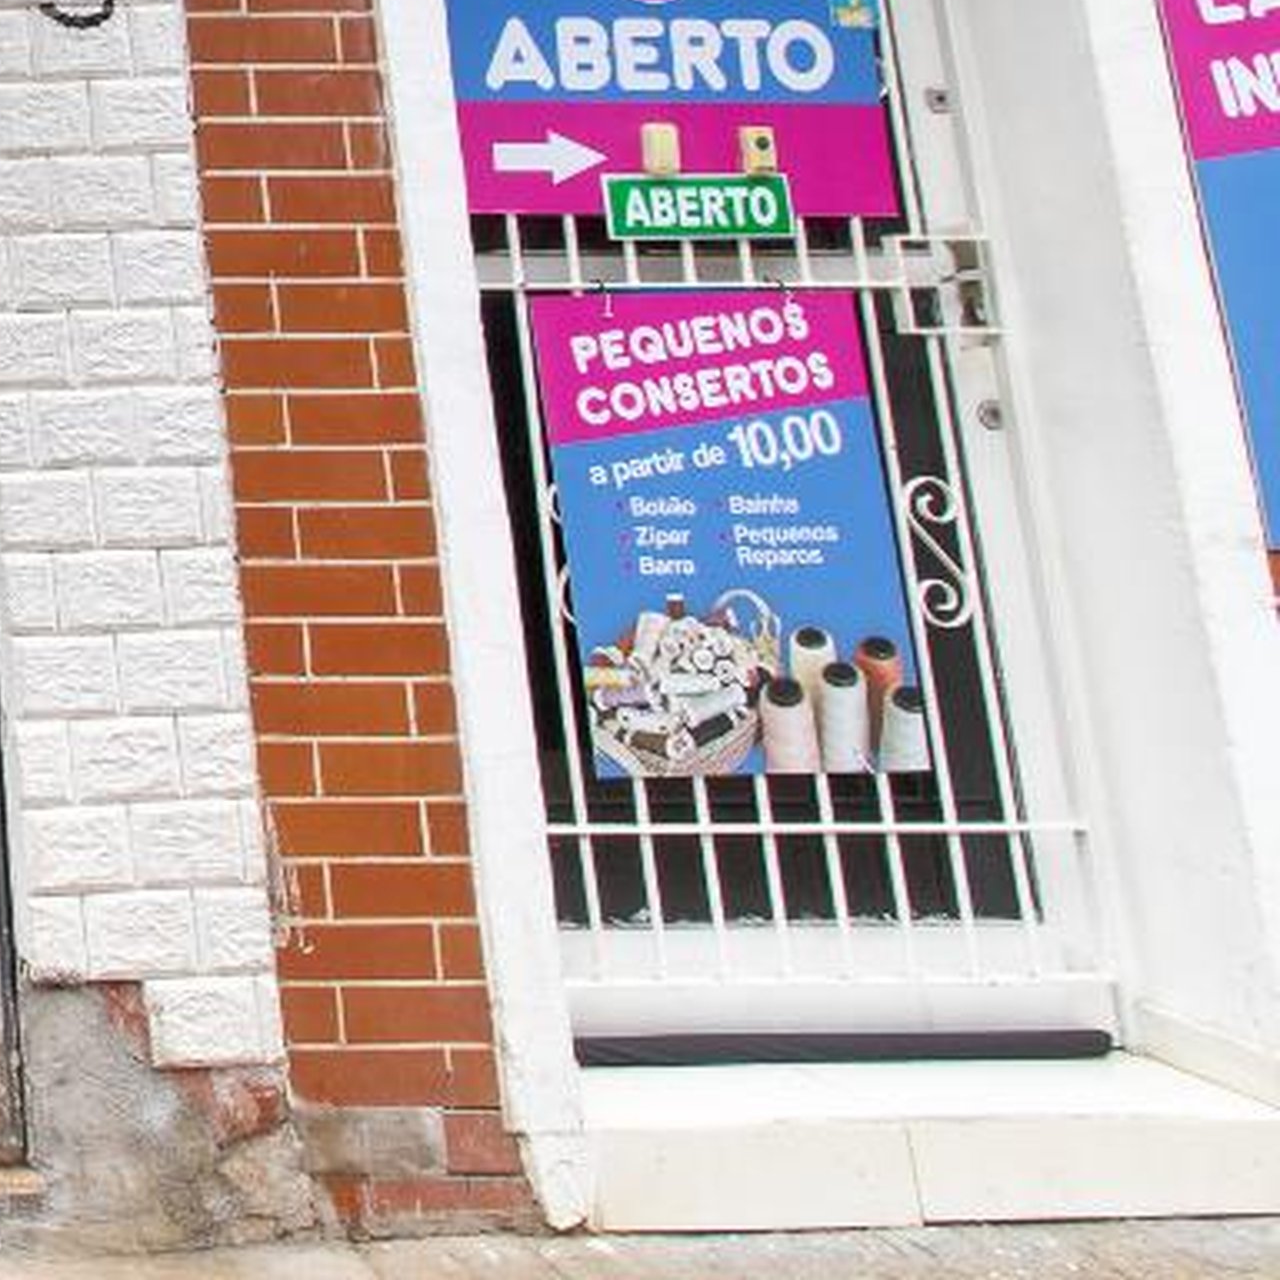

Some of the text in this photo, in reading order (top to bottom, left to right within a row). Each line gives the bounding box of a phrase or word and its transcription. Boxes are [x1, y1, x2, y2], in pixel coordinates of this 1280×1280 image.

[485, 17, 835, 92] ABERTO
[1210, 50, 1280, 118] IN
[625, 186, 778, 228] ABERTO
[570, 302, 810, 374] PEQUENOS
[576, 352, 835, 426] CONSERTOS
[589, 410, 842, 489] a partir de 10,00
[629, 495, 697, 517] Botão
[729, 493, 800, 515] Bainha
[733, 523, 839, 549] Pequenos
[640, 556, 695, 576] Barra
[737, 546, 825, 570] Reparos
